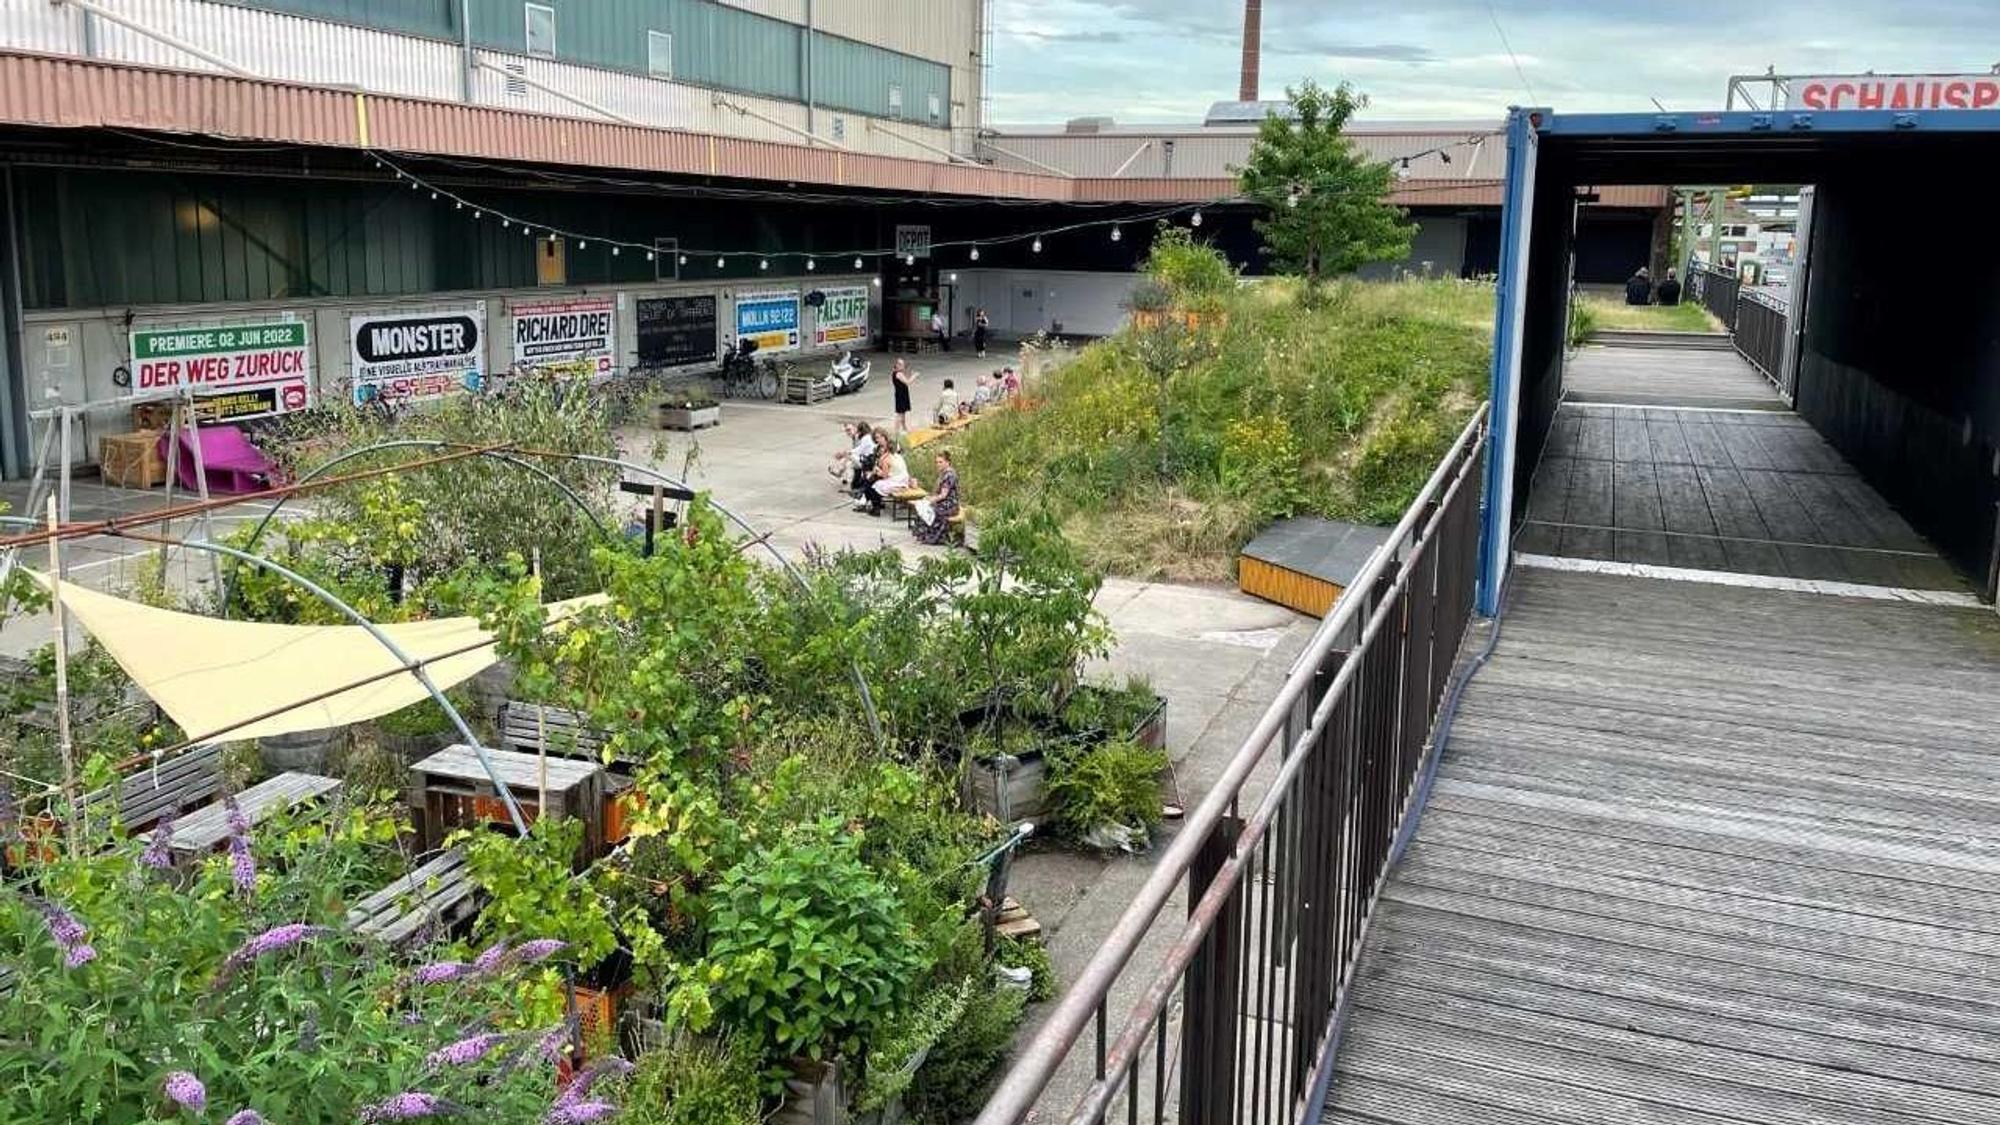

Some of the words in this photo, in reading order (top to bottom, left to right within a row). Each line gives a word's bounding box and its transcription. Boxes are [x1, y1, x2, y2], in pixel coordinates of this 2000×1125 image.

[218, 334, 235, 348] 02
[237, 331, 261, 346] JUN
[262, 328, 293, 344] 2022
[371, 322, 465, 356] MONSTER
[516, 314, 578, 343] RICHARD
[579, 312, 611, 337] DREI
[140, 360, 181, 388] DER
[186, 356, 229, 383] WEG
[234, 350, 304, 378] ZURÜCK
